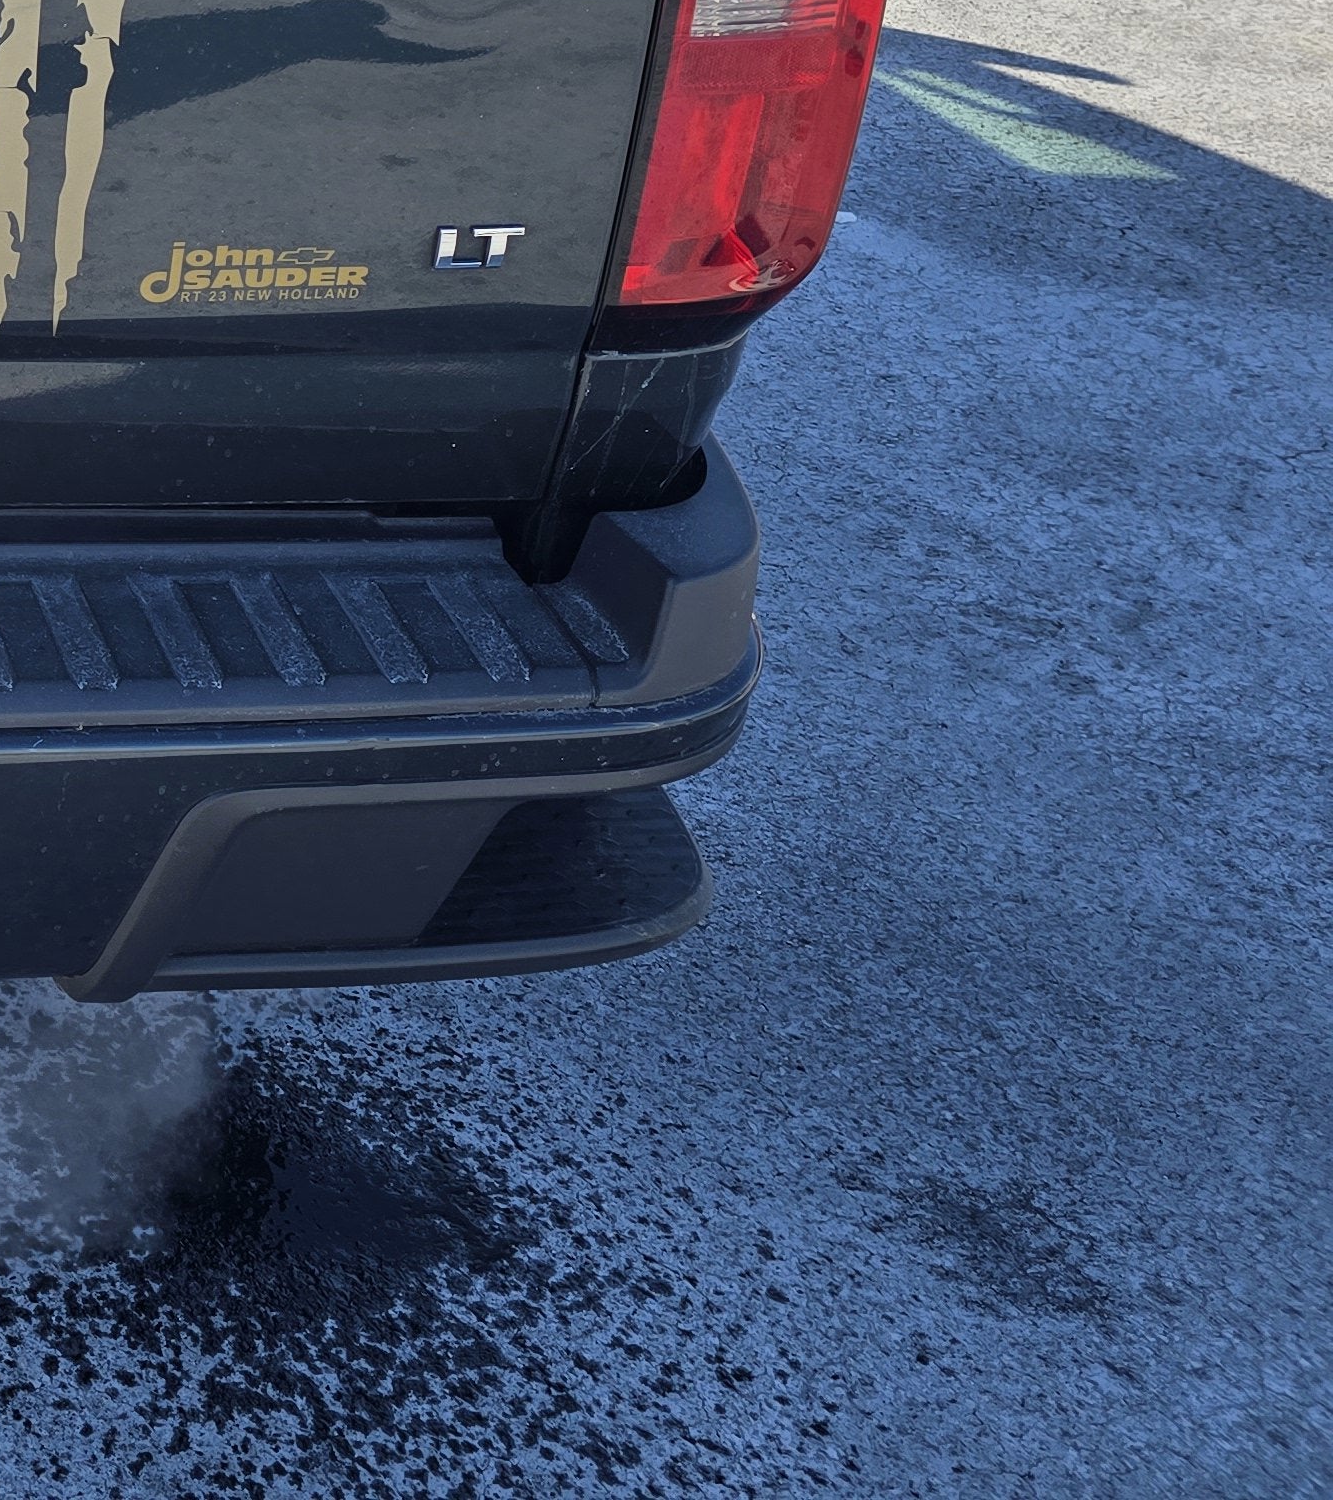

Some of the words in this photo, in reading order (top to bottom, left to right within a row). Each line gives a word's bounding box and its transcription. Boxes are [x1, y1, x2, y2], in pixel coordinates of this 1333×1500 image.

[434, 224, 526, 269] LT
[139, 241, 278, 304] john
[183, 266, 369, 289] SAUDER
[209, 291, 228, 303] 23
[234, 289, 272, 302] NEW
[278, 287, 360, 301] HOLLAND
